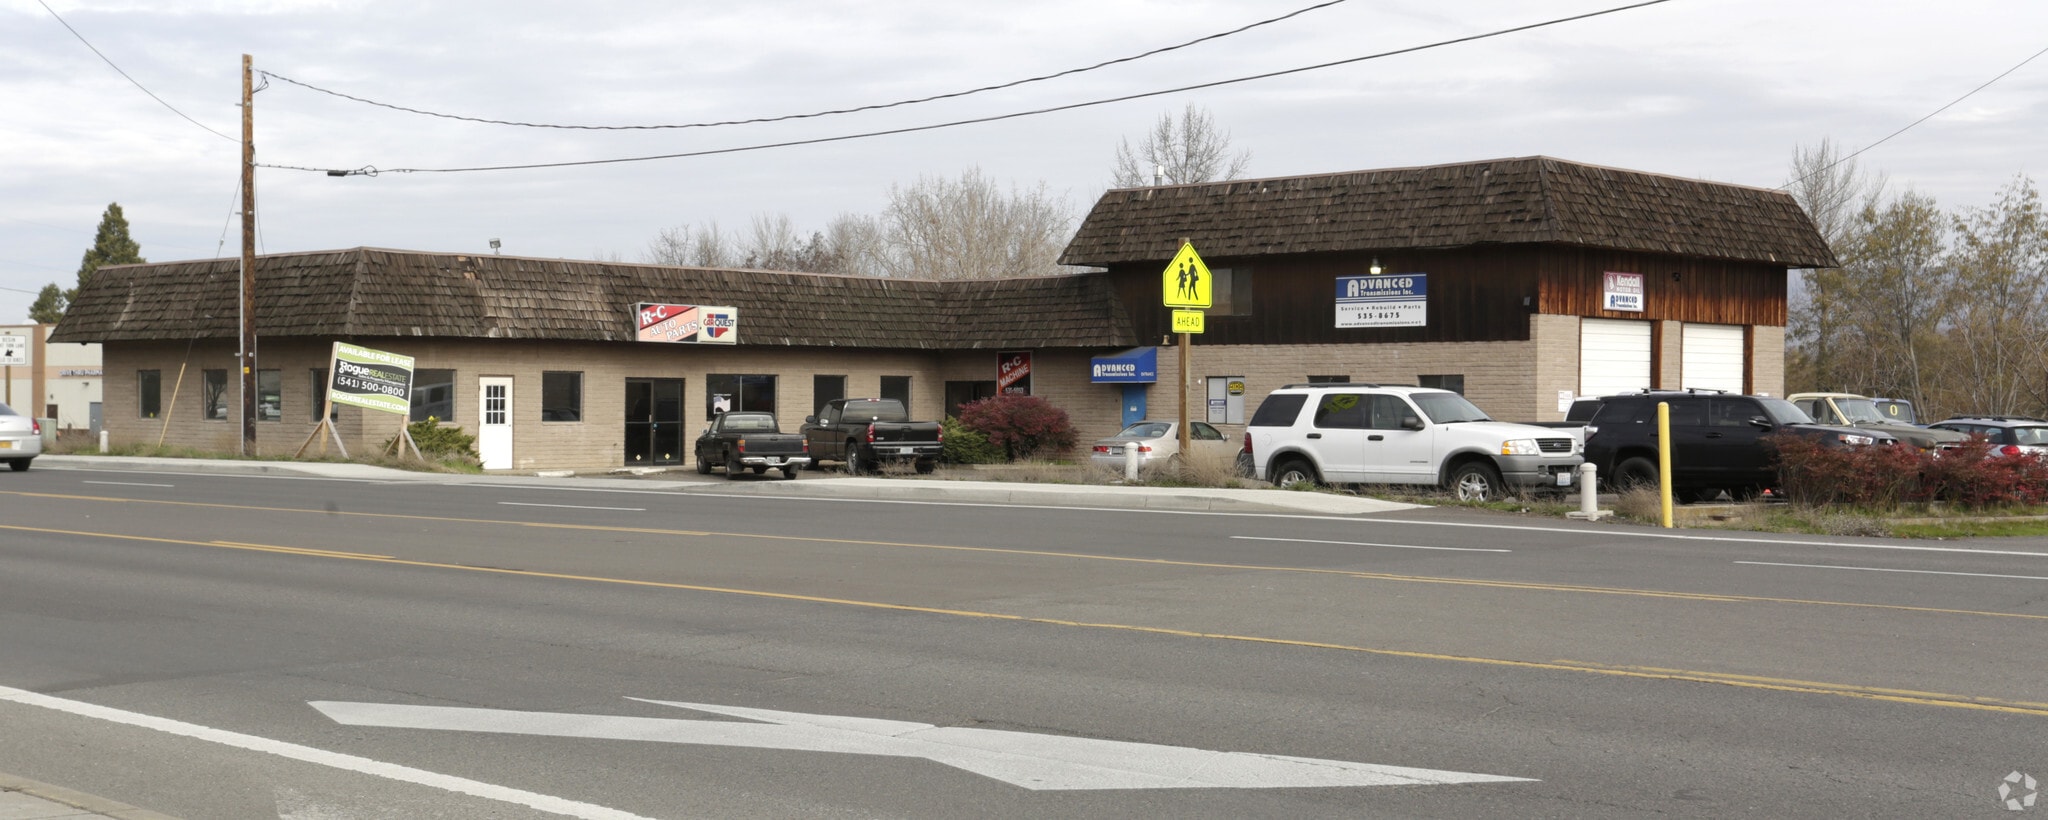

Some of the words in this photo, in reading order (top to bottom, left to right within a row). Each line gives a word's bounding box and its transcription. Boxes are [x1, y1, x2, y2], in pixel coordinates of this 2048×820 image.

[1347, 278, 1413, 297] ADVANCED
[1616, 275, 1640, 288] Kendall
[1360, 289, 1401, 297] Transmissions
[1610, 294, 1638, 307] ADVANCED
[641, 306, 667, 325] R-C
[1176, 316, 1200, 327] AHEAD
[650, 320, 676, 336] AUTO
[666, 320, 698, 340] PARTS
[339, 346, 375, 360] AVAILABLE
[376, 354, 390, 363] FOR
[390, 356, 412, 367] LEASE
[1000, 364, 1029, 386] MACHINE
[1094, 364, 1136, 377] ADVANCED
[337, 377, 359, 388] (541)
[361, 381, 404, 397] 500-0800
[331, 393, 407, 411] ROGUEREALESTATE.COM
